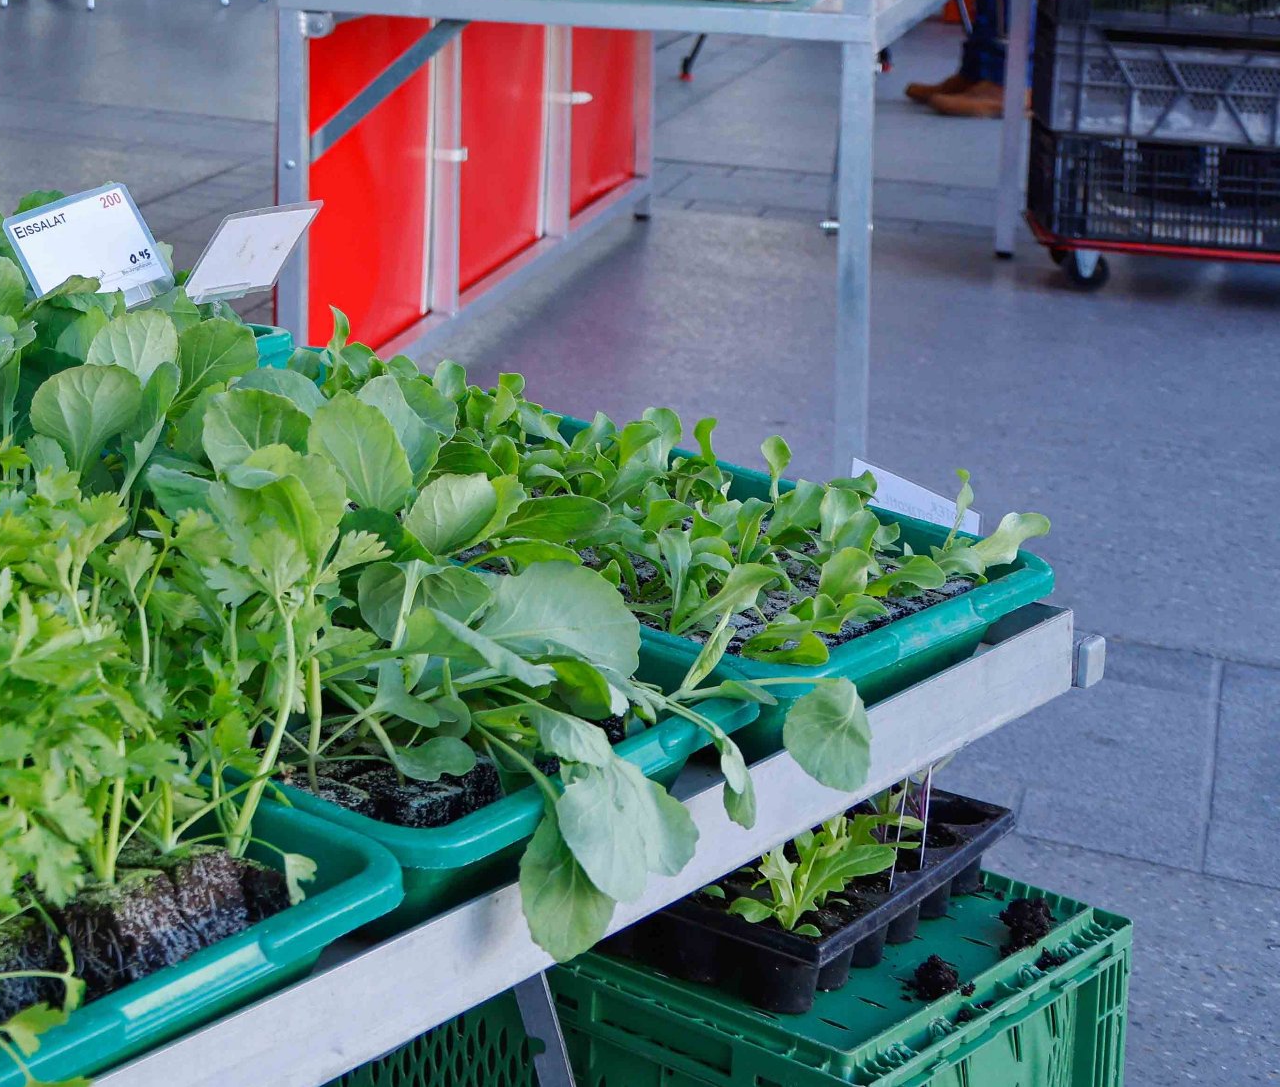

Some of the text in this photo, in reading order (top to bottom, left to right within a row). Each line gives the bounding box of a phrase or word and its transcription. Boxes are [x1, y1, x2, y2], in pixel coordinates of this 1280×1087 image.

[99, 192, 122, 209] 200
[13, 213, 67, 239] EISSALAT
[129, 248, 151, 264] 0.45
